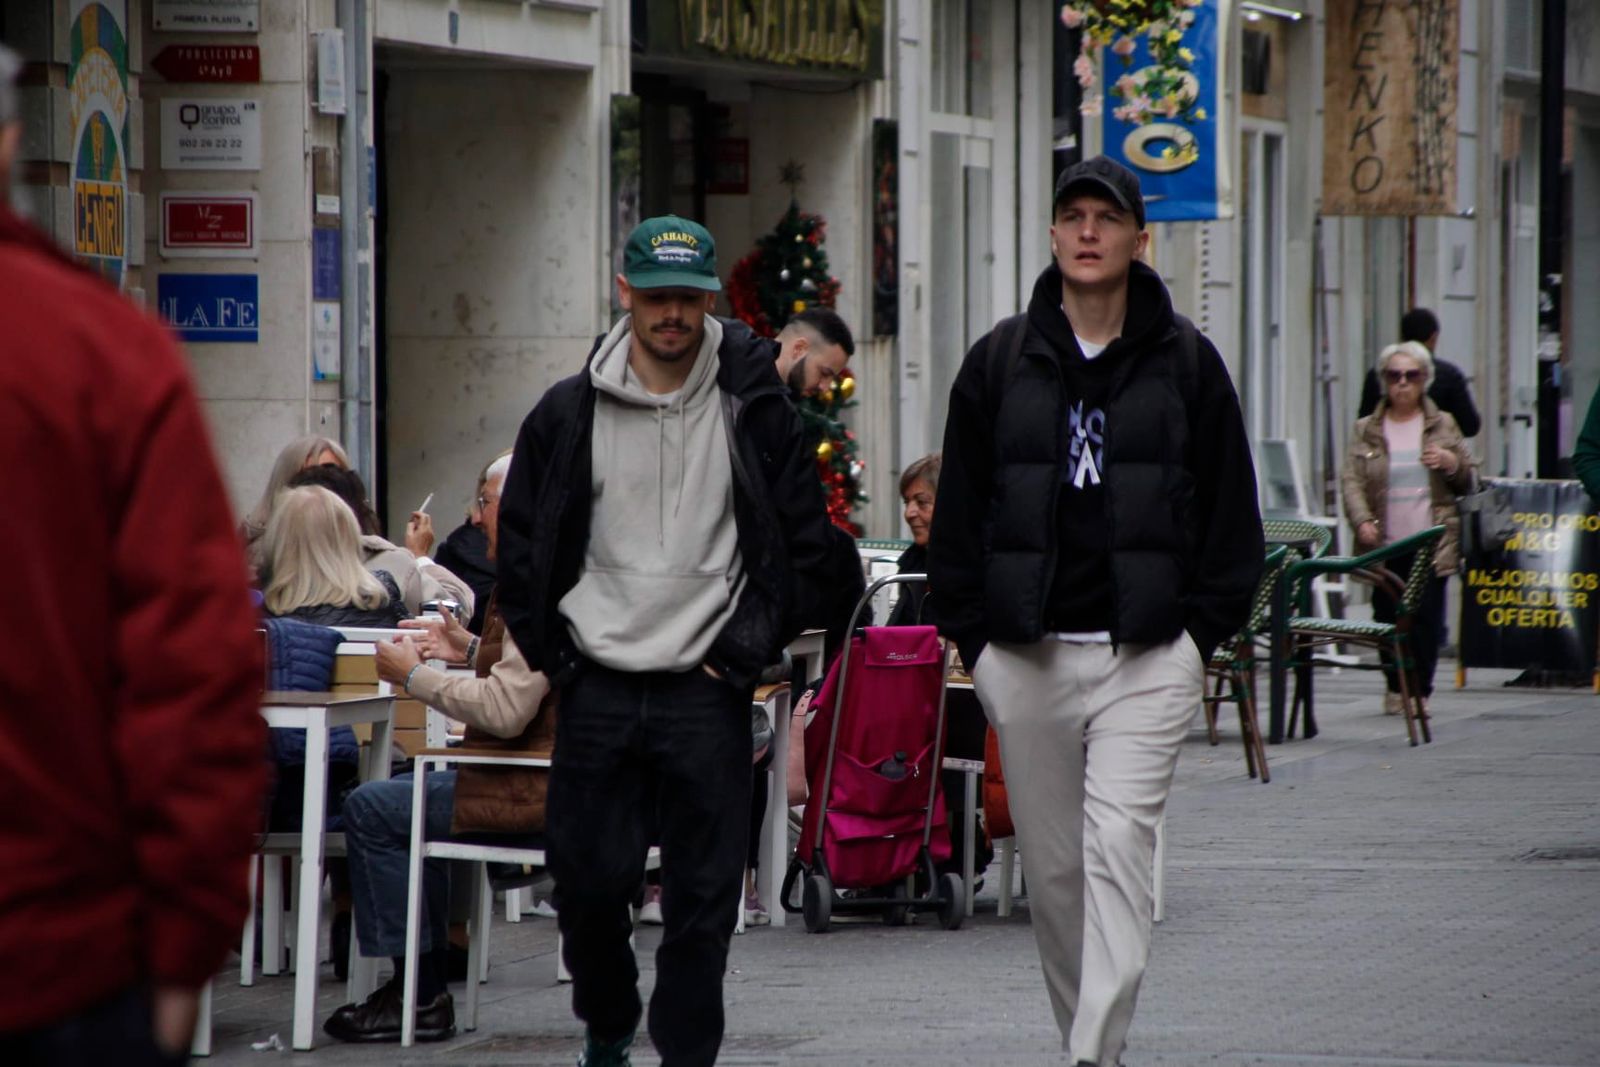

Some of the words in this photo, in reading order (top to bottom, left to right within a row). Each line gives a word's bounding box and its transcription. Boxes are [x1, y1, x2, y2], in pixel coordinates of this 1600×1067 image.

[652, 232, 697, 247] CARHARTT
[215, 296, 256, 328] FE
[1477, 589, 1588, 607] CUALQUER
[1488, 609, 1575, 627] OFERTA
